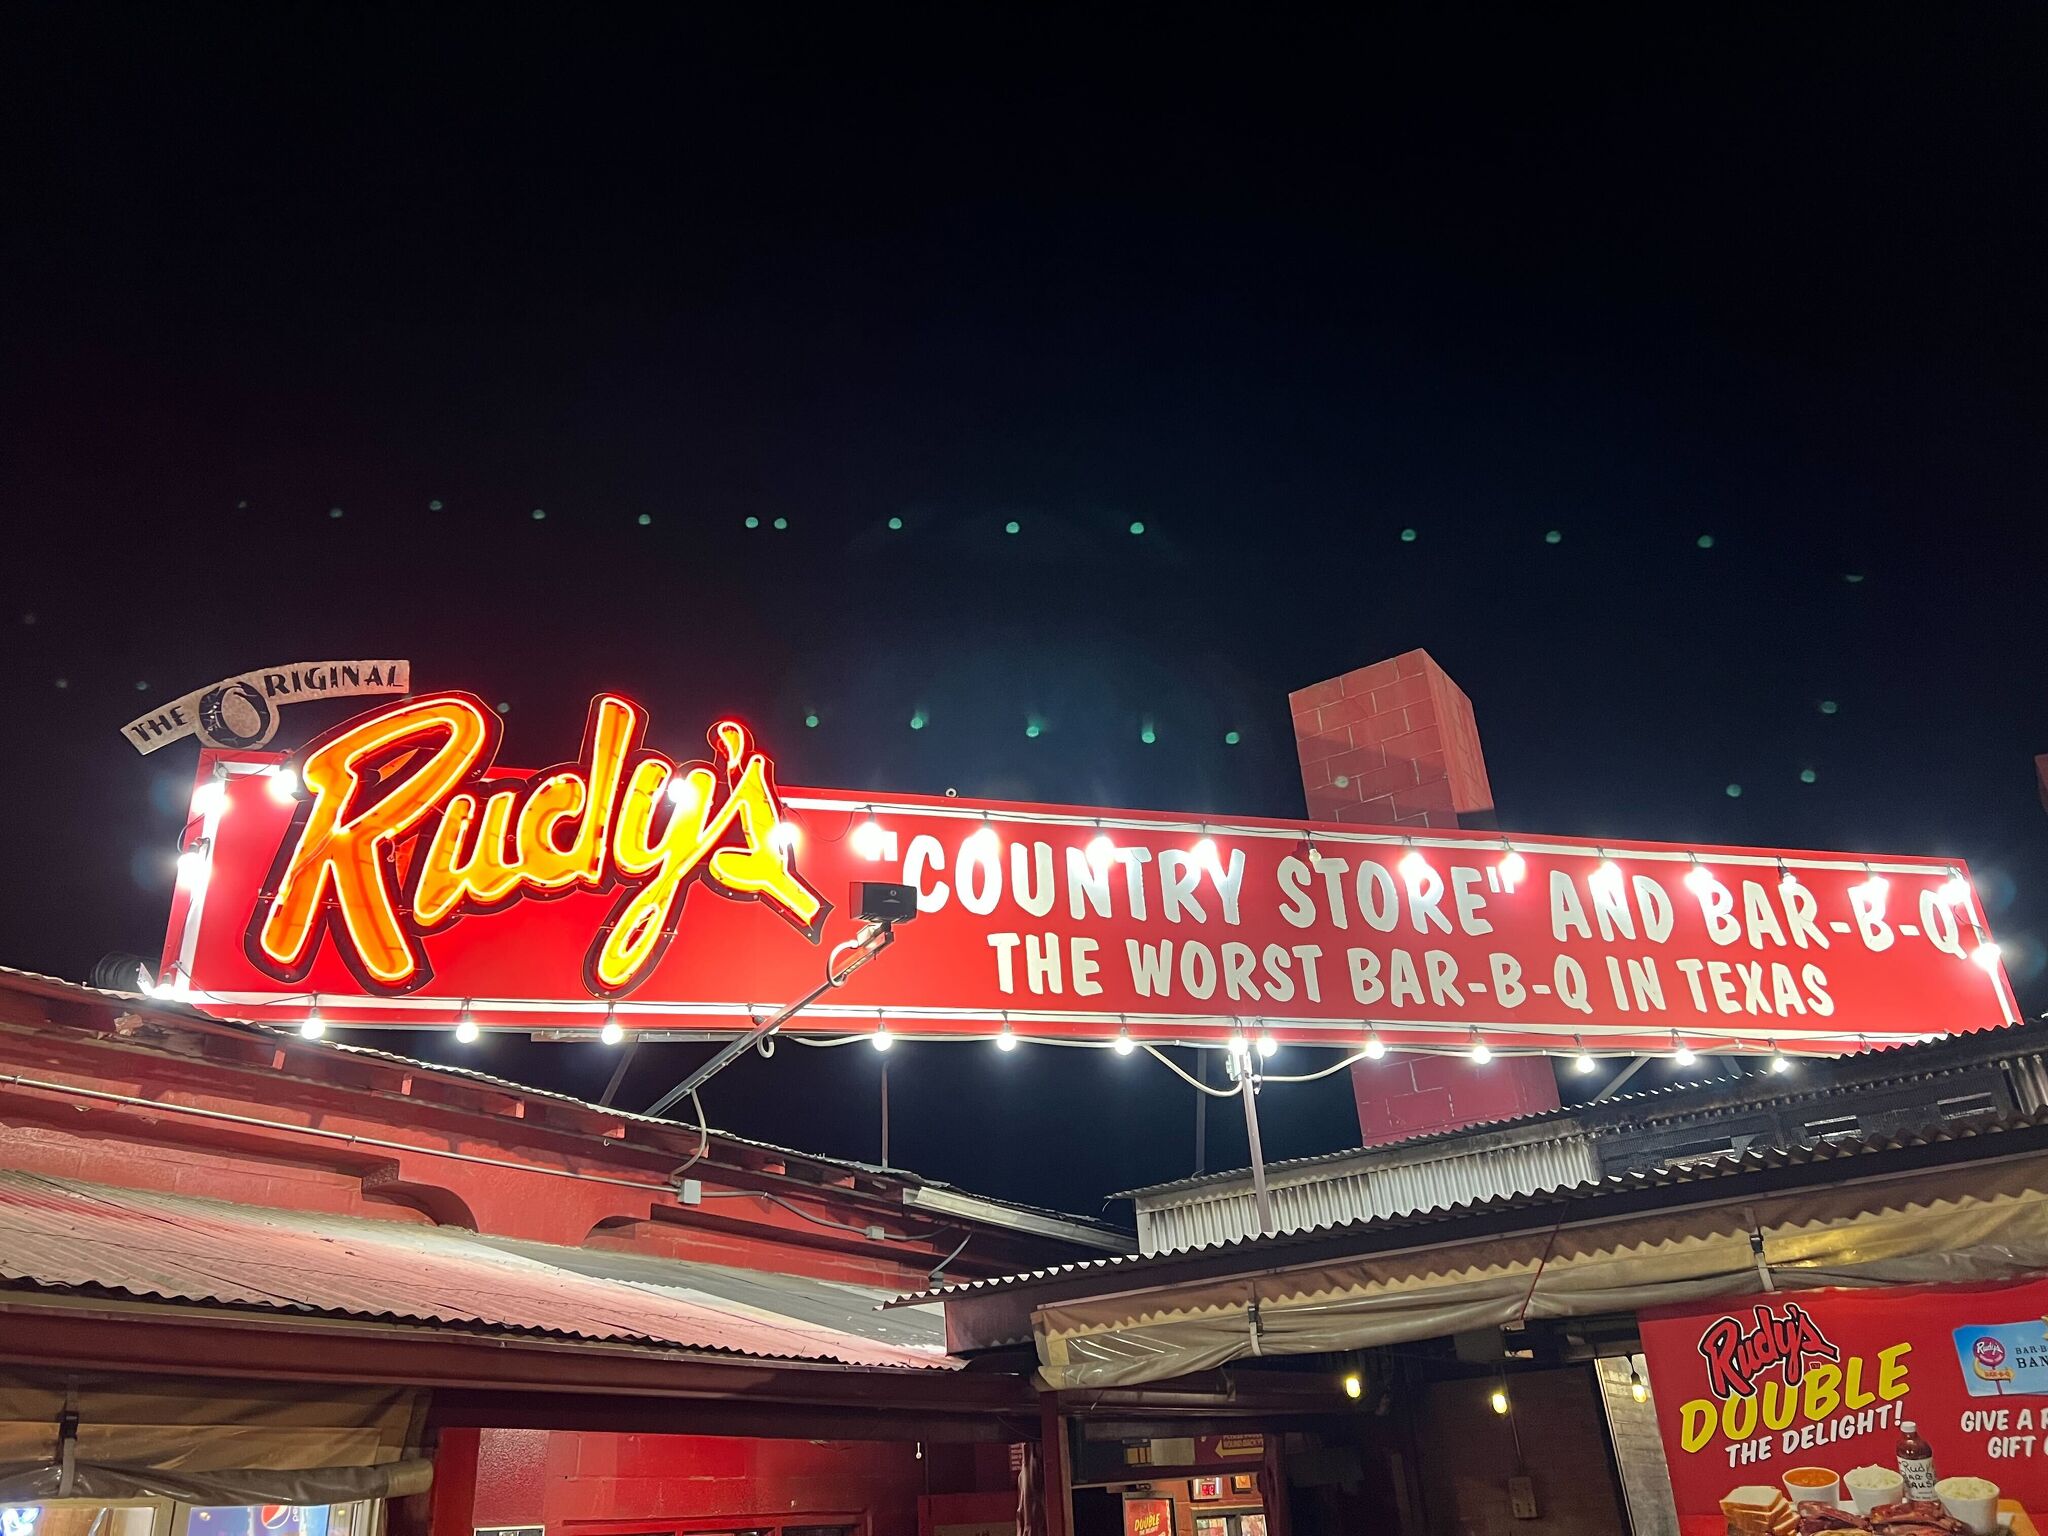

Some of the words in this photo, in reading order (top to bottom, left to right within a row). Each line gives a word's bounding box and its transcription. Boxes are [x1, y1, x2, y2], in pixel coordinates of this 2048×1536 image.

[130, 705, 191, 742] THE
[250, 690, 826, 993] Rudy's
[1276, 855, 1517, 937] STORE"
[1549, 867, 1675, 944] AND
[1689, 875, 1968, 960] BAR-B-Q
[986, 931, 1103, 997] THE
[1125, 938, 1323, 1003] WORST
[1347, 946, 1594, 1015] BAR-B-Q
[1606, 955, 1667, 1013] IN
[1676, 957, 1835, 1018] TEXAS
[1698, 1302, 1840, 1400] Rudy's
[1680, 1342, 1912, 1453] DOUBLE
[1725, 1435, 1773, 1468] THE
[1782, 1400, 1903, 1455] DELIGHT!
[1960, 1409, 2010, 1433] GIVE
[2016, 1408, 2034, 1431] A
[1987, 1435, 2038, 1459] GIFT
